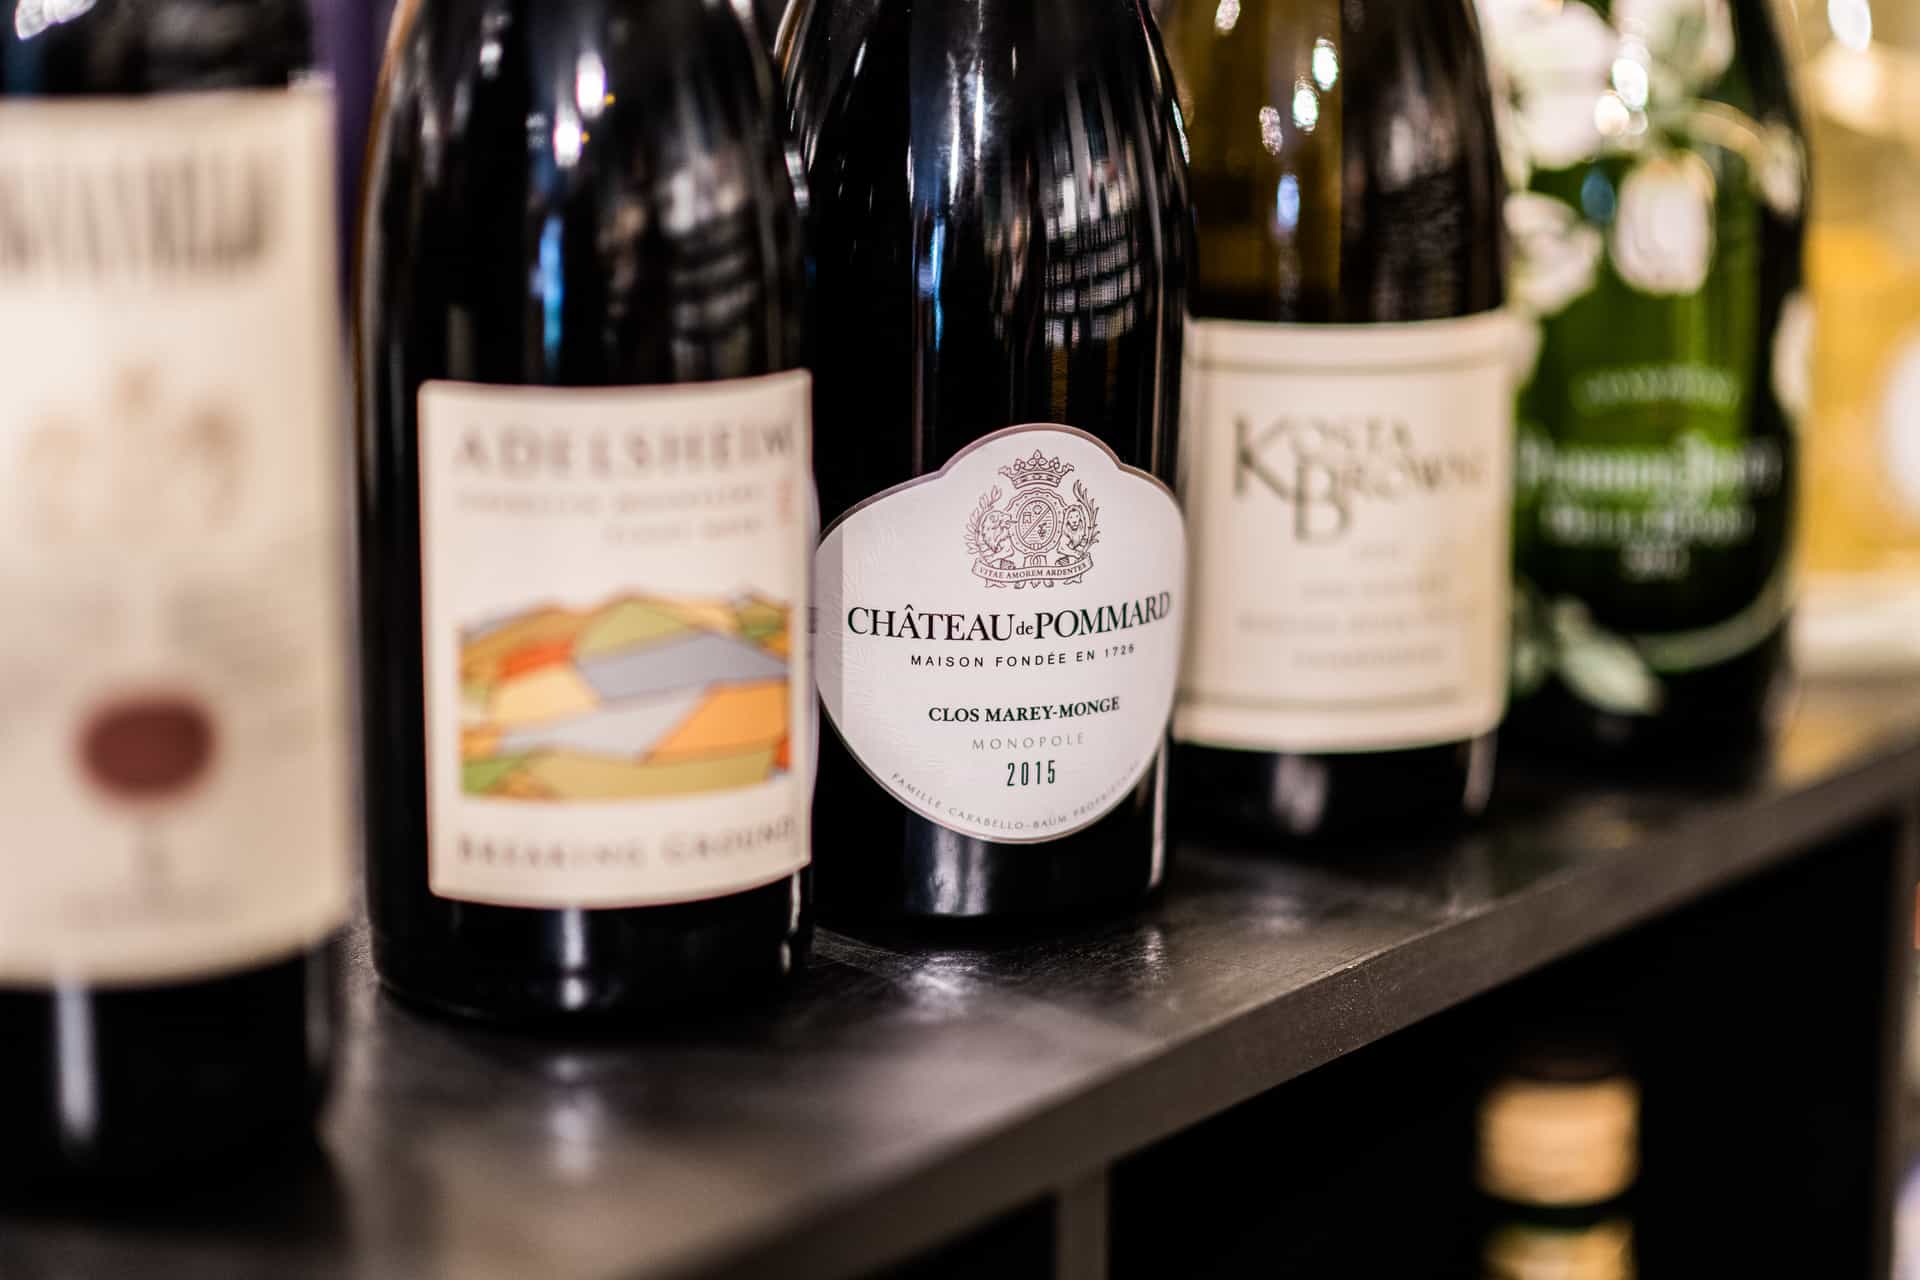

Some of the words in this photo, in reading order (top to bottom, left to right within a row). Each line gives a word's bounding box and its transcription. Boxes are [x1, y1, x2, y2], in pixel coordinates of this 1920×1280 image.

[980, 567, 1005, 578] VITAE
[1006, 570, 1043, 579] AMOREM
[848, 604, 1016, 641] CHÂTEAU
[1016, 621, 1034, 635] de
[1034, 591, 1171, 640] POMMARD
[911, 655, 984, 667] MAISON
[996, 652, 1067, 668] FONDÉE
[1076, 650, 1096, 662] EN
[928, 707, 980, 722] CLOS
[985, 696, 1121, 722] MAREY-MONGE
[972, 732, 1086, 750] MONOPOLE
[1007, 760, 1056, 786] 2015
